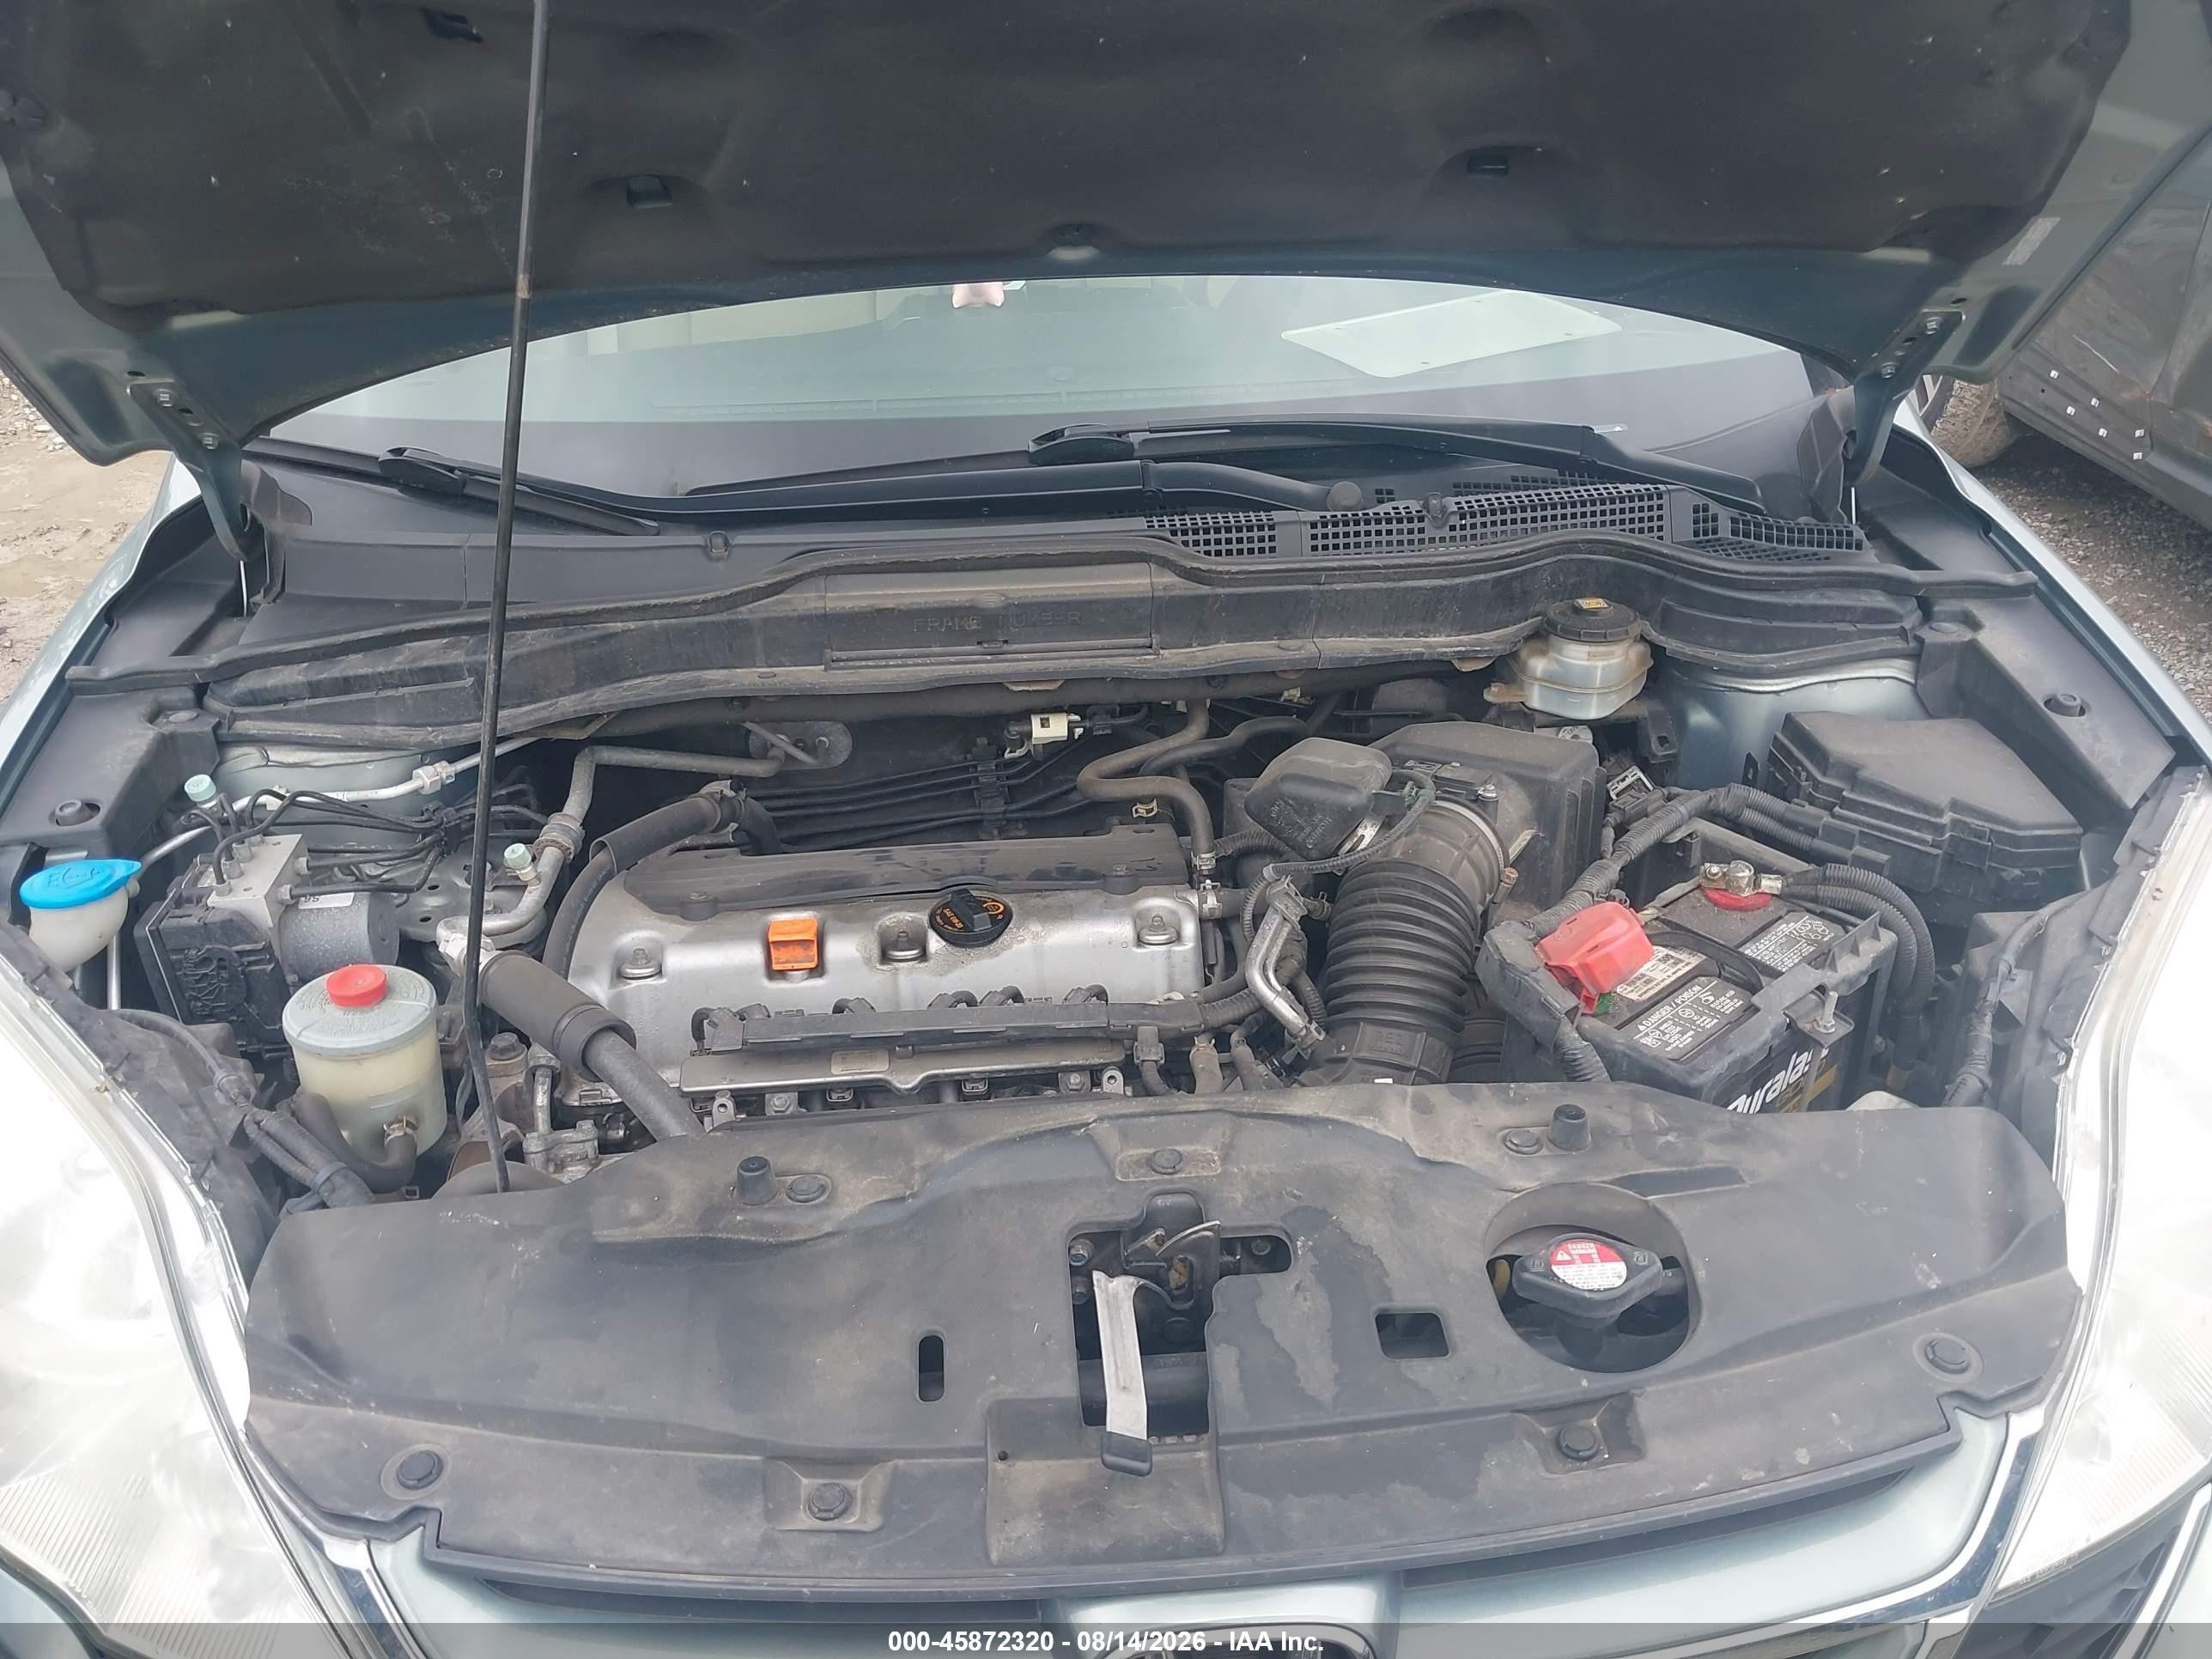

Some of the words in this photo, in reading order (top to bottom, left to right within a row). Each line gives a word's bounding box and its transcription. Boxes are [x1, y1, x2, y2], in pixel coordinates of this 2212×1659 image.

[913, 615, 982, 631] FRAME
[997, 611, 1082, 629] NUMBER
[1643, 1006, 1674, 1028] DANGER
[1674, 984, 1703, 1005] POISON
[1727, 1047, 1829, 1114] Durala
